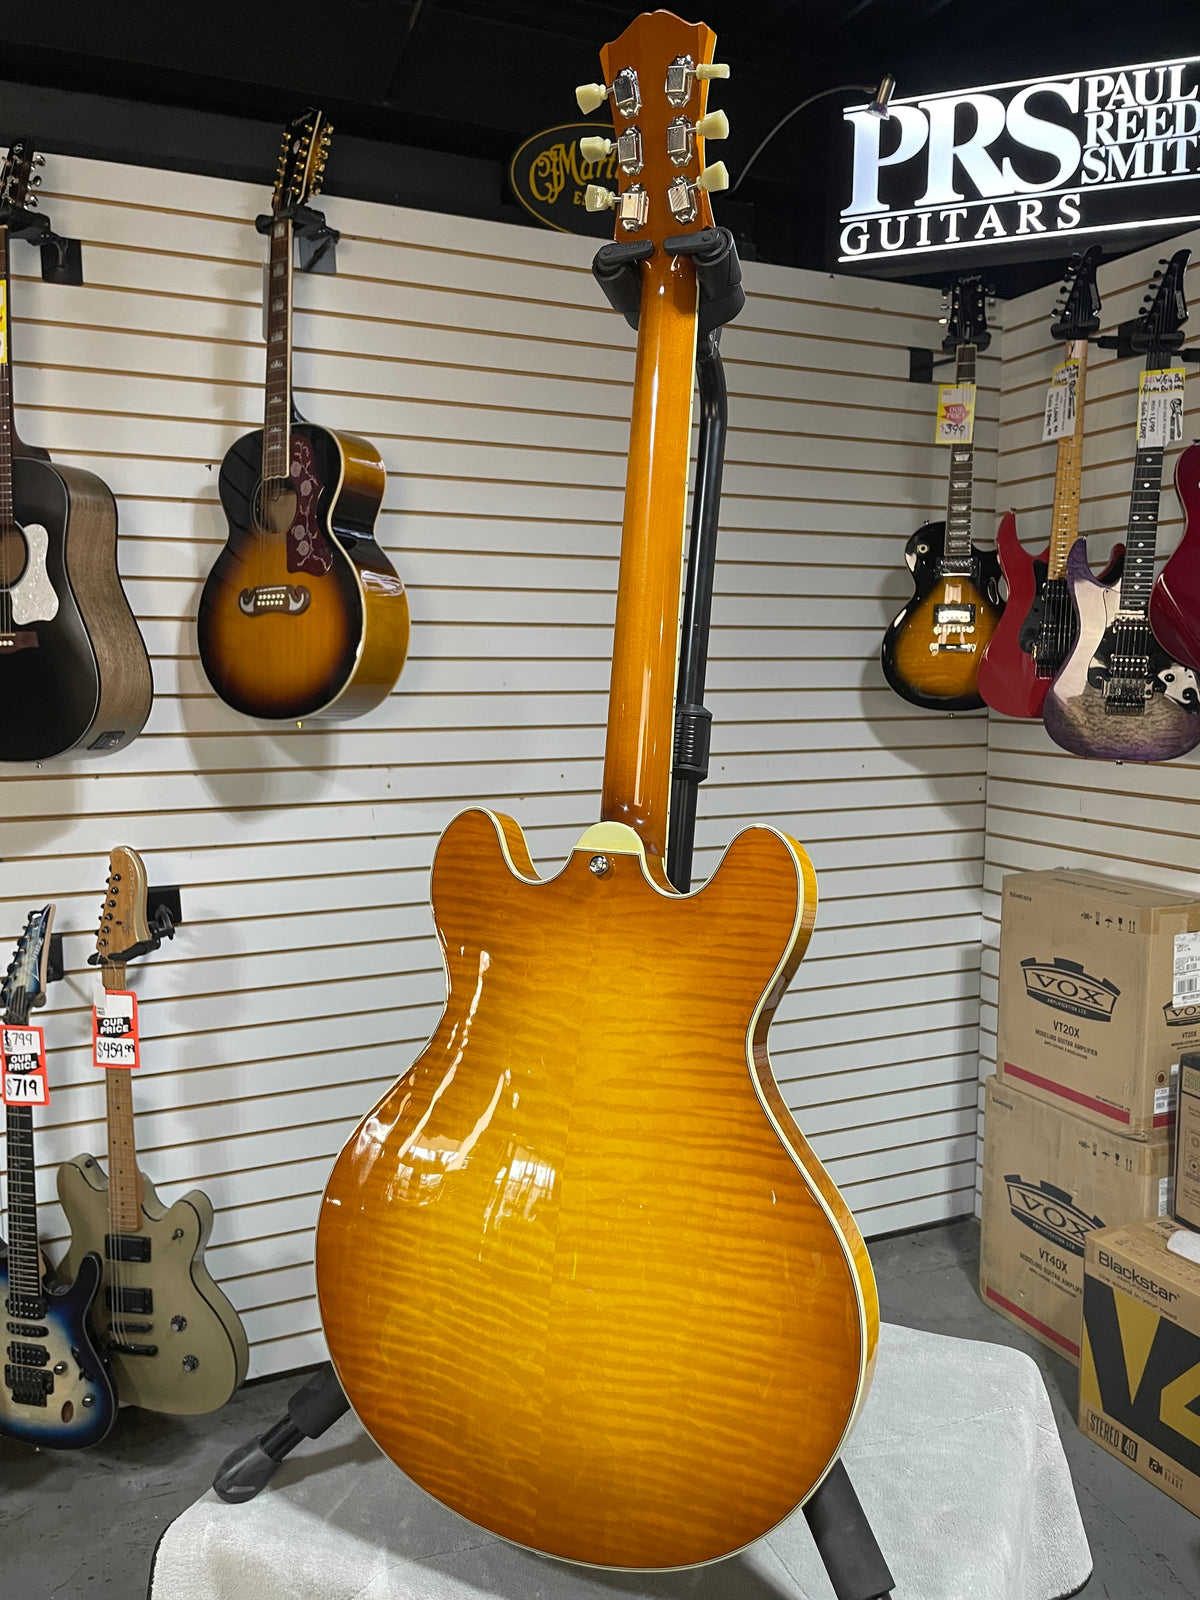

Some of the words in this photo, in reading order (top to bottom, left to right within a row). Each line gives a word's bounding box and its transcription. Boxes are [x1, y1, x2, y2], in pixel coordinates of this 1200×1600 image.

[1083, 64, 1199, 113] PAUL
[1083, 99, 1200, 150] REED
[840, 78, 1082, 217] PRS
[1081, 135, 1200, 185] SMIT
[838, 193, 1082, 256] GUITARS
[1032, 972, 1104, 1006] VOX
[99, 1024, 130, 1035] PRICE
[102, 1017, 124, 1027] OUR
[1052, 1020, 1080, 1039] VT20X
[8, 1060, 38, 1072] PRICE
[10, 1054, 32, 1063] OUR
[6, 1078, 38, 1097] $719
[1017, 1190, 1091, 1241] VOX
[1038, 1247, 1068, 1275] VT40X
[1098, 1250, 1178, 1303] Blackstar
[1089, 1413, 1120, 1448] STEREO
[1124, 1439, 1137, 1459] 40
